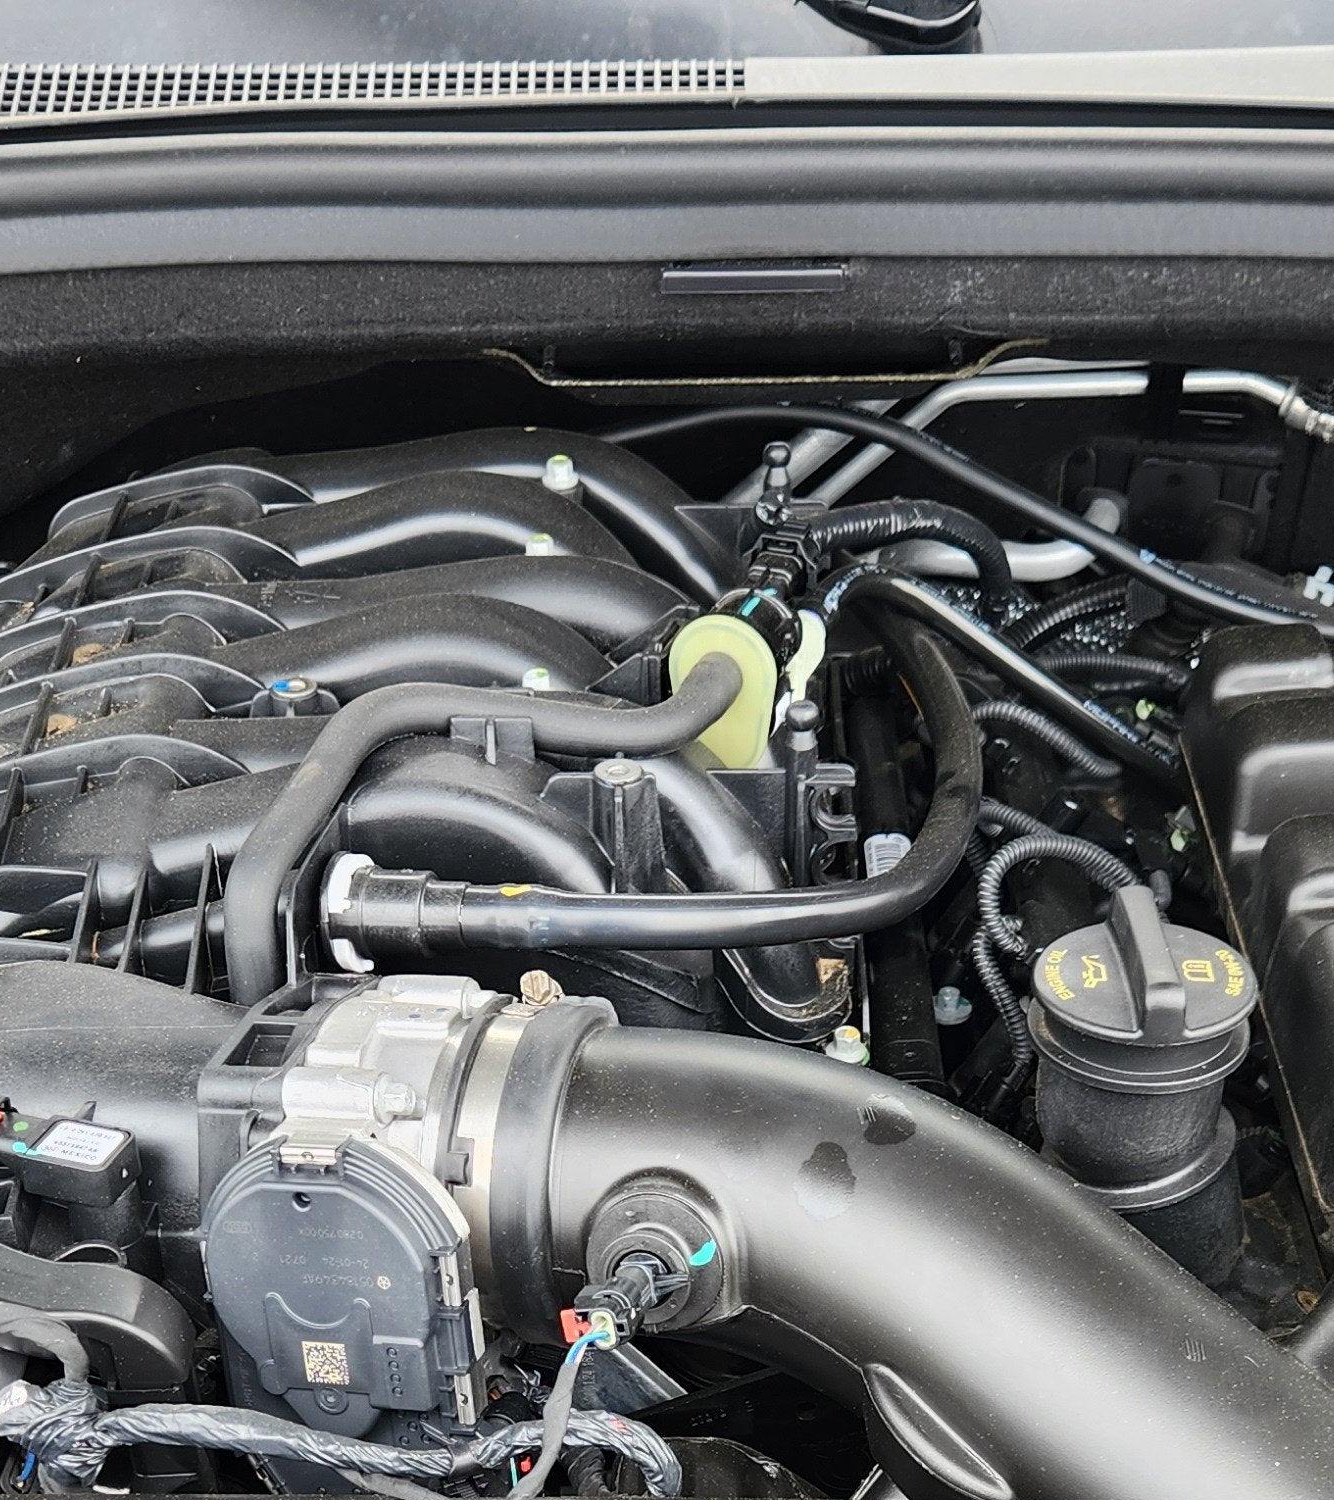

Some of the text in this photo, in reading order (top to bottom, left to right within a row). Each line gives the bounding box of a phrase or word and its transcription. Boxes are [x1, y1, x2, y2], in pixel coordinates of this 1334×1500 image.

[1043, 949, 1075, 1001] ENGINE OIL
[1224, 975, 1245, 997] SAE
